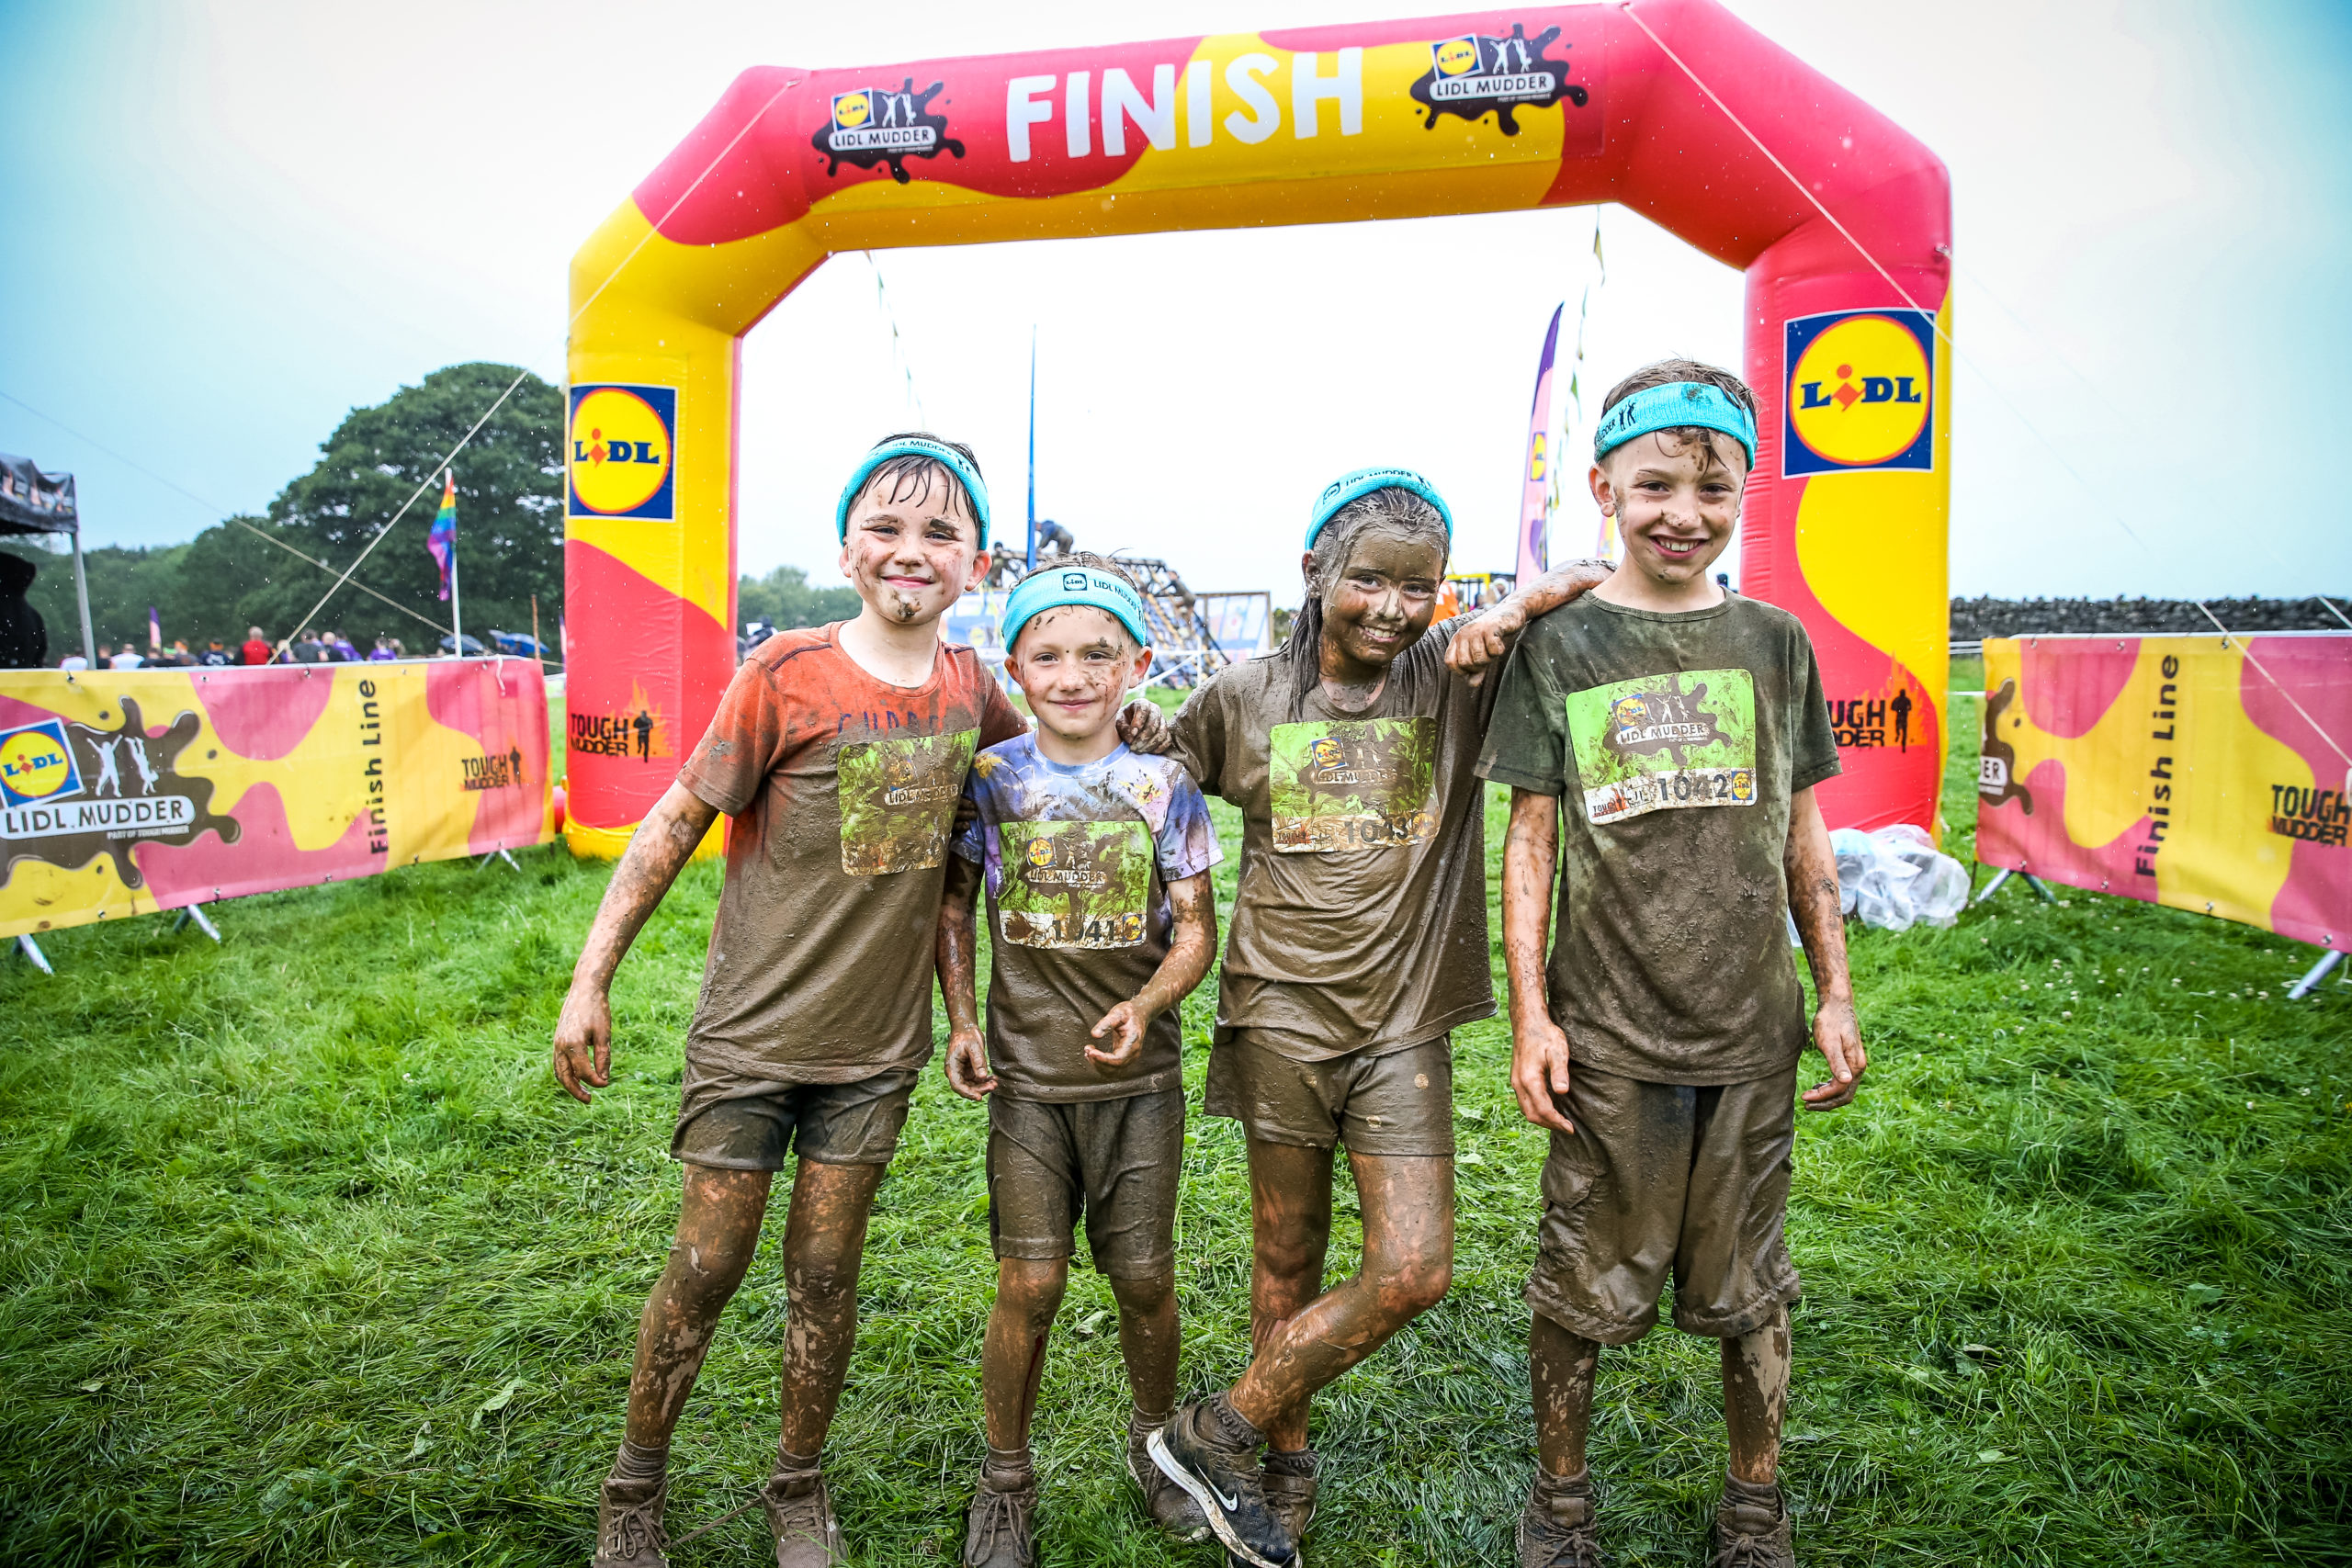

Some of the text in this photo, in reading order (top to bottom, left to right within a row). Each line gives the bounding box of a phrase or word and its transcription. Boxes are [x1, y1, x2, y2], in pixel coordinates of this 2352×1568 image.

[1437, 75, 1547, 96] LIDL MUDDER
[1006, 47, 1363, 163] FINISH
[834, 130, 930, 147] LIDL MUDDER
[1093, 579, 1114, 592] LIDL
[571, 713, 628, 740] TOUGH
[1826, 700, 1885, 728] UGH
[1620, 724, 1704, 743] LIDL MUDDER
[1833, 729, 1884, 748] DER
[571, 736, 628, 757] MUDDER
[358, 679, 389, 854] Finish Line
[461, 754, 508, 777] TOUGH
[2134, 654, 2179, 877] Finish Line
[464, 774, 510, 791] MUDDER
[6, 800, 184, 833] LIDL MUDDER
[2272, 784, 2351, 825] TOUGH
[2273, 816, 2347, 847] MUDDER
